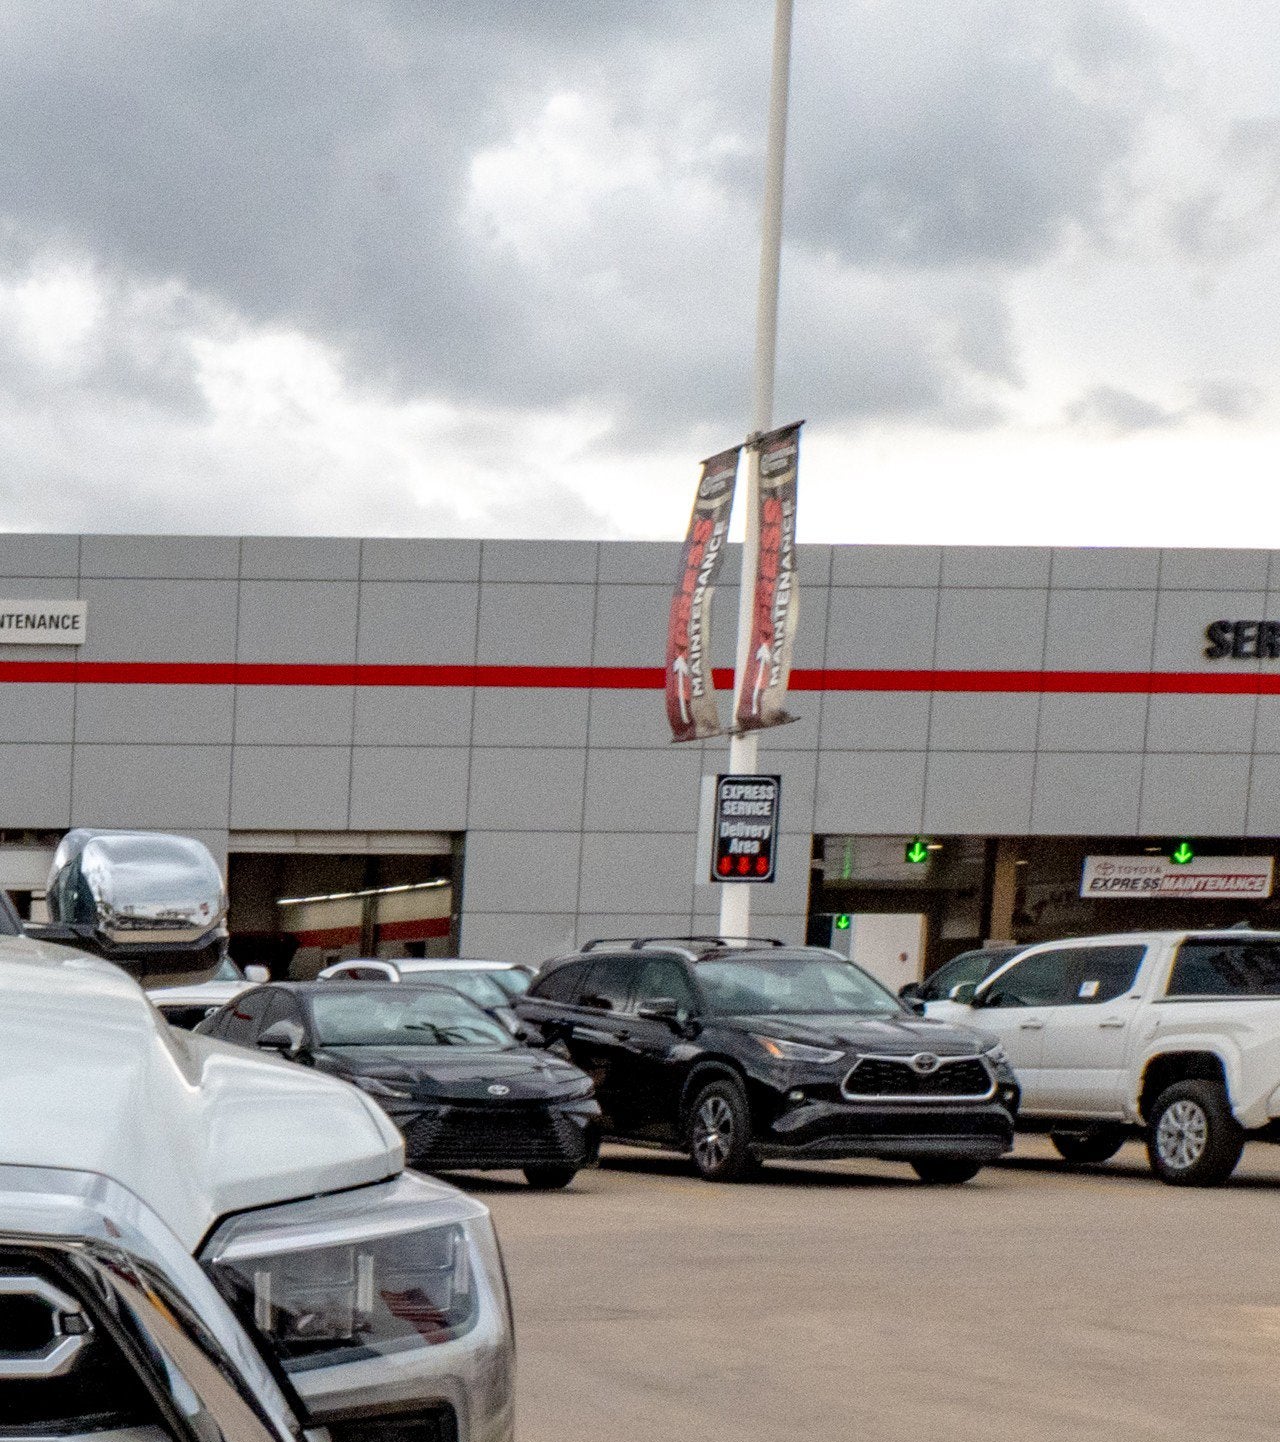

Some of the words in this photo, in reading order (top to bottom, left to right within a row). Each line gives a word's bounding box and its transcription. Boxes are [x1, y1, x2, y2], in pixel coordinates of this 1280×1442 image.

[768, 503, 796, 687] MAINTENANCE
[688, 519, 725, 698] MAINTENANCE
[721, 784, 774, 800] EXPRESS
[722, 801, 772, 816] SERVICE
[719, 821, 772, 840] Delivery
[729, 838, 760, 854] Area
[1089, 877, 1161, 890] EXPRESS
